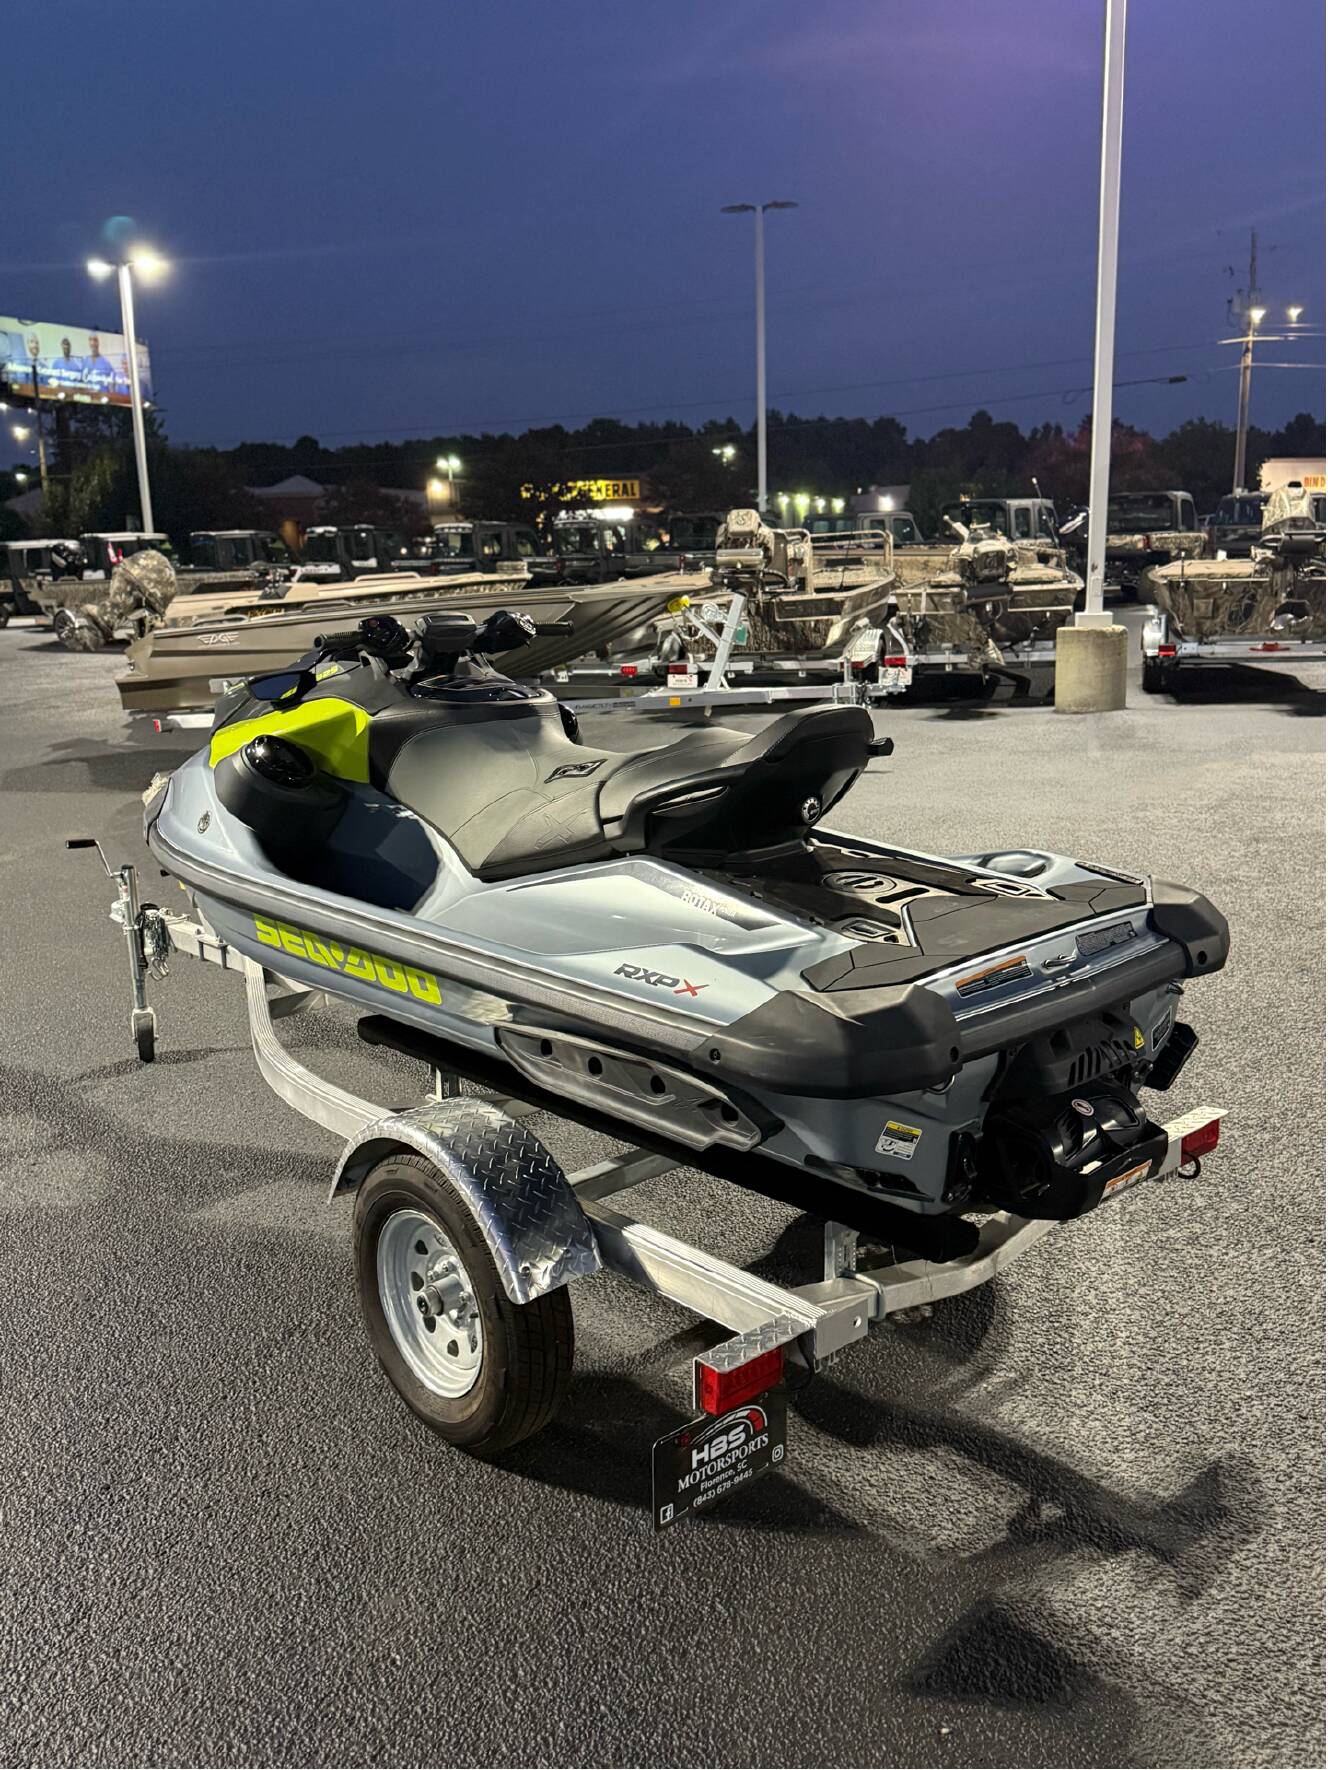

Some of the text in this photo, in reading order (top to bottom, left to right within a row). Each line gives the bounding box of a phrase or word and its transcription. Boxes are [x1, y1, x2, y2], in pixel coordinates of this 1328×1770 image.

[681, 890, 719, 916] ROTAX
[677, 1433, 769, 1493] MOTORSPORTS
[700, 1460, 748, 1492] Florence, SC
[692, 1490, 716, 1508] (843)
